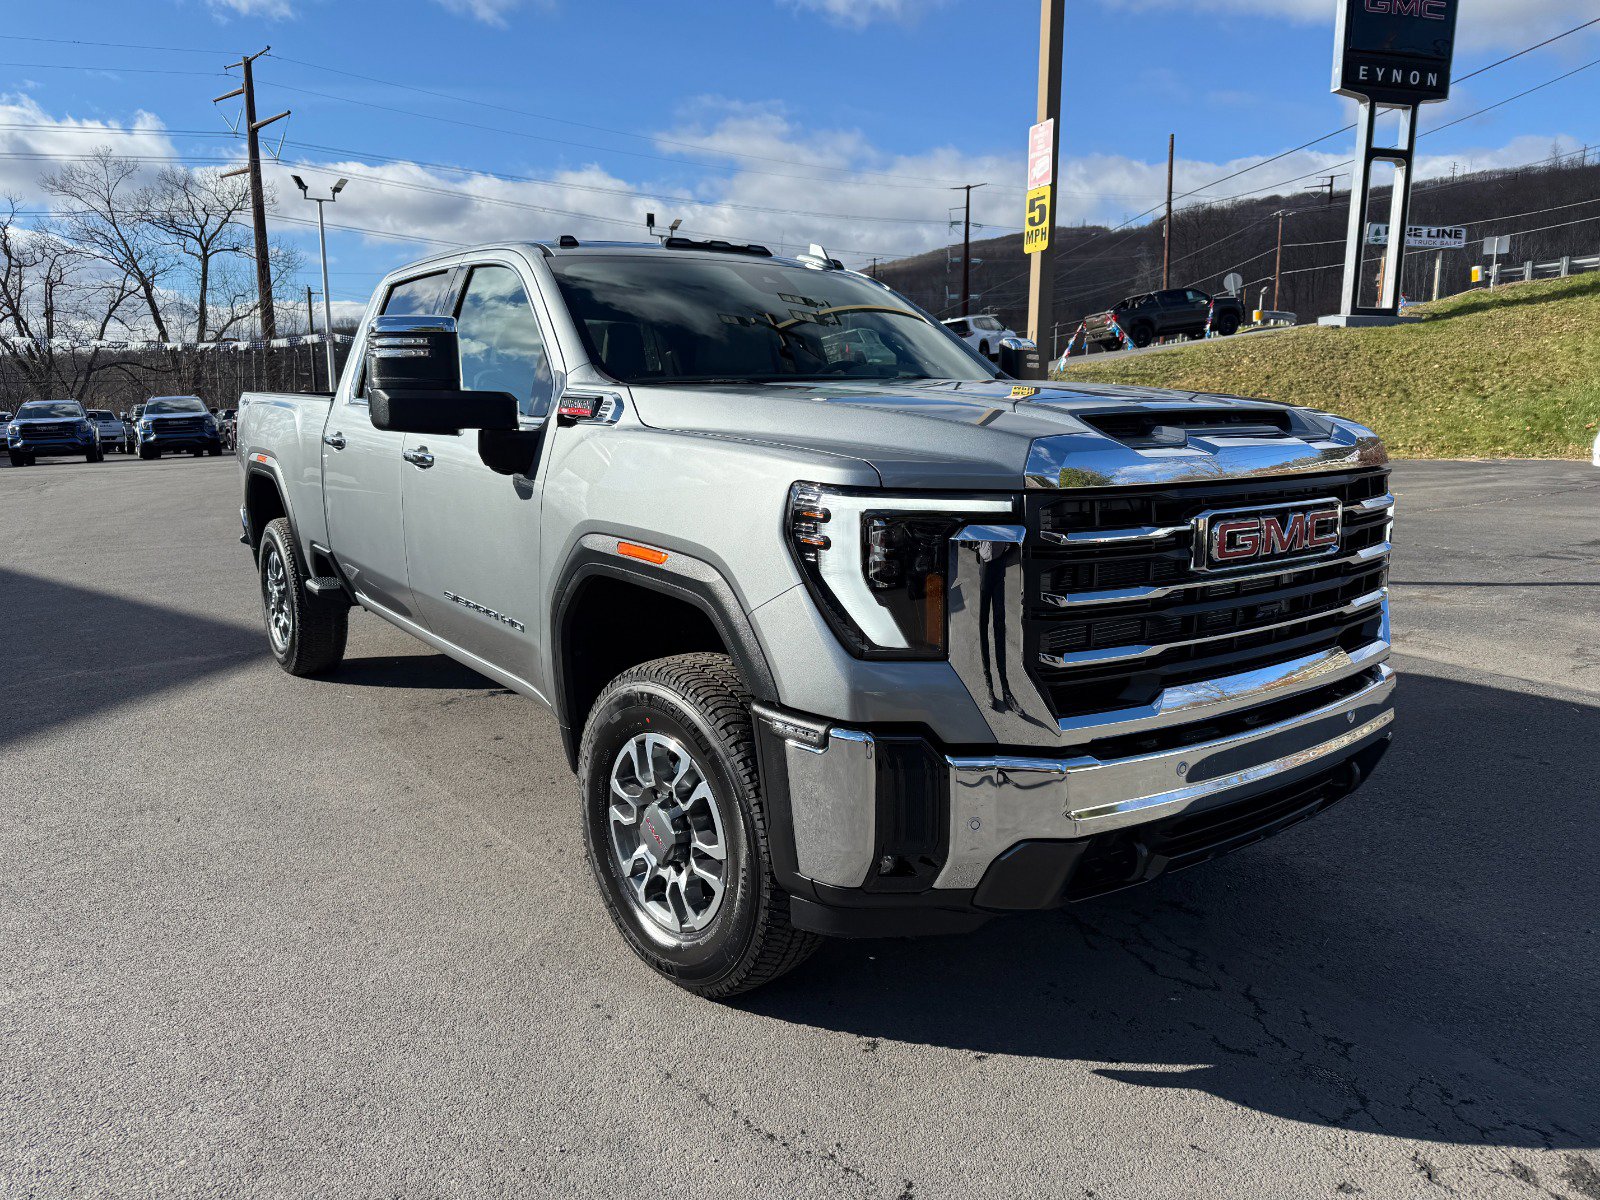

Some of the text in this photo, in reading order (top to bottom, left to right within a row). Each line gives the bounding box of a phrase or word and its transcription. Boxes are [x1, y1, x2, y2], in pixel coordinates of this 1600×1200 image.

[1364, 0, 1446, 20] GMC
[1359, 65, 1438, 87] EYNON
[1028, 195, 1047, 227] 5
[1026, 227, 1047, 245] MPH
[1427, 228, 1463, 239] LINE
[1212, 510, 1339, 561] GMC
